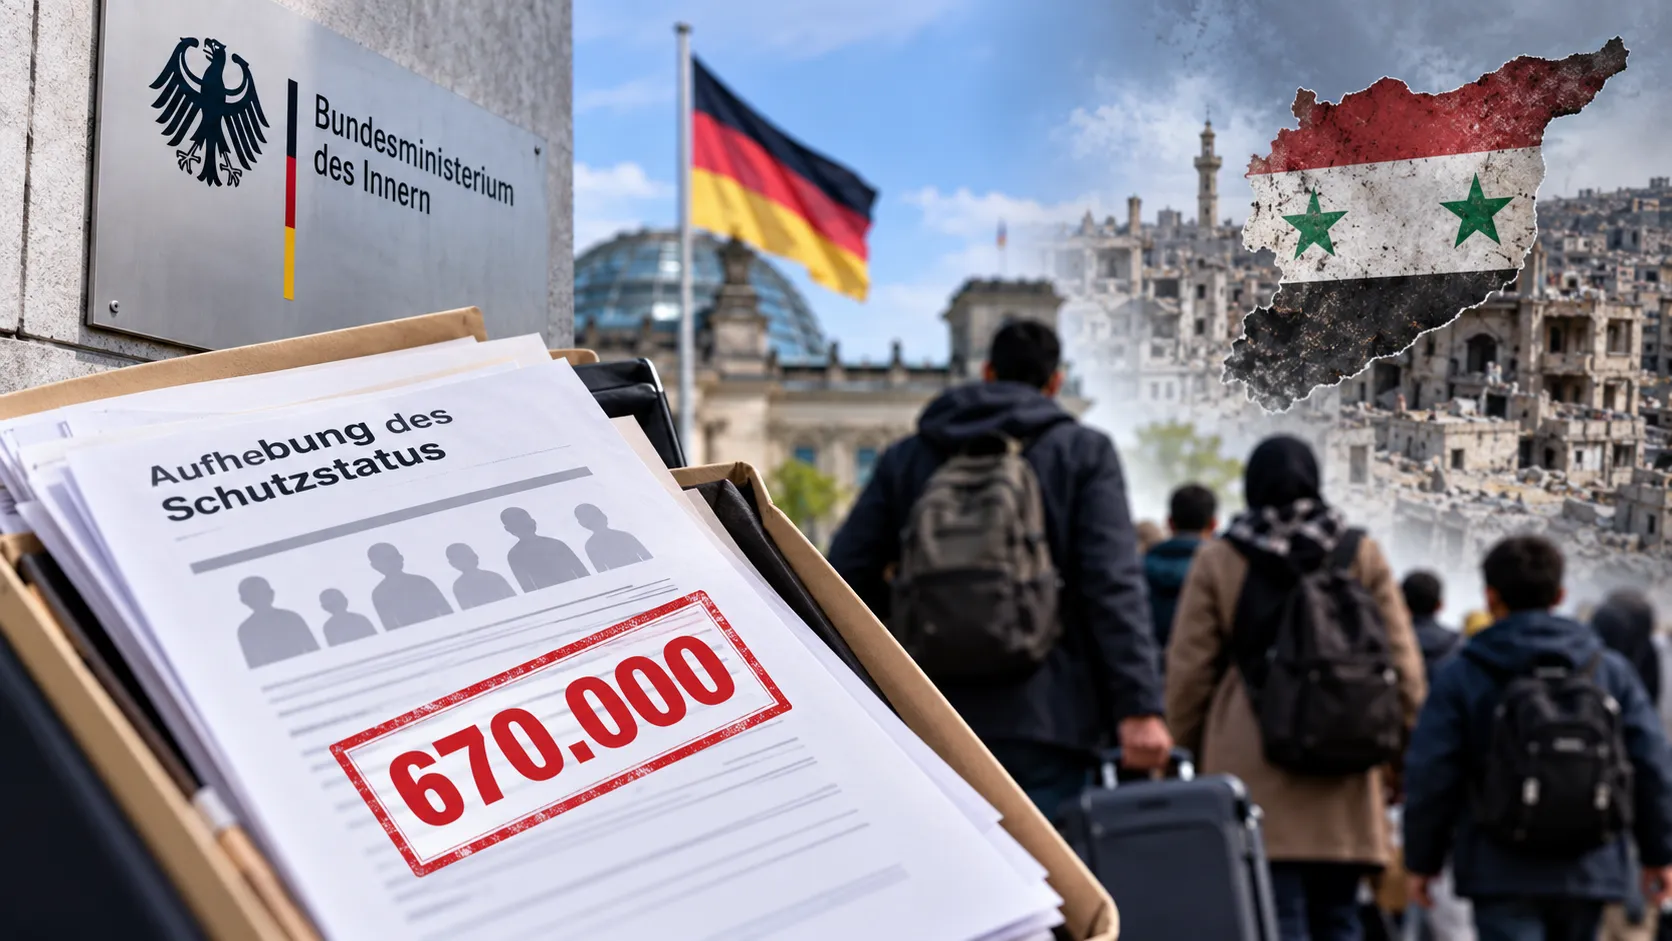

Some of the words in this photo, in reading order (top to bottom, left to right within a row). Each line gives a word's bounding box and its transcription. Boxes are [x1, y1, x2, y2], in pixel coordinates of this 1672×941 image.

[314, 143, 354, 186] des
[364, 159, 431, 214] Innern
[315, 93, 514, 206] Bundesministerium
[151, 421, 376, 487] Aufhebung
[385, 408, 454, 434] des
[162, 442, 447, 522] Schutzstatus
[388, 635, 736, 827] 670.000
